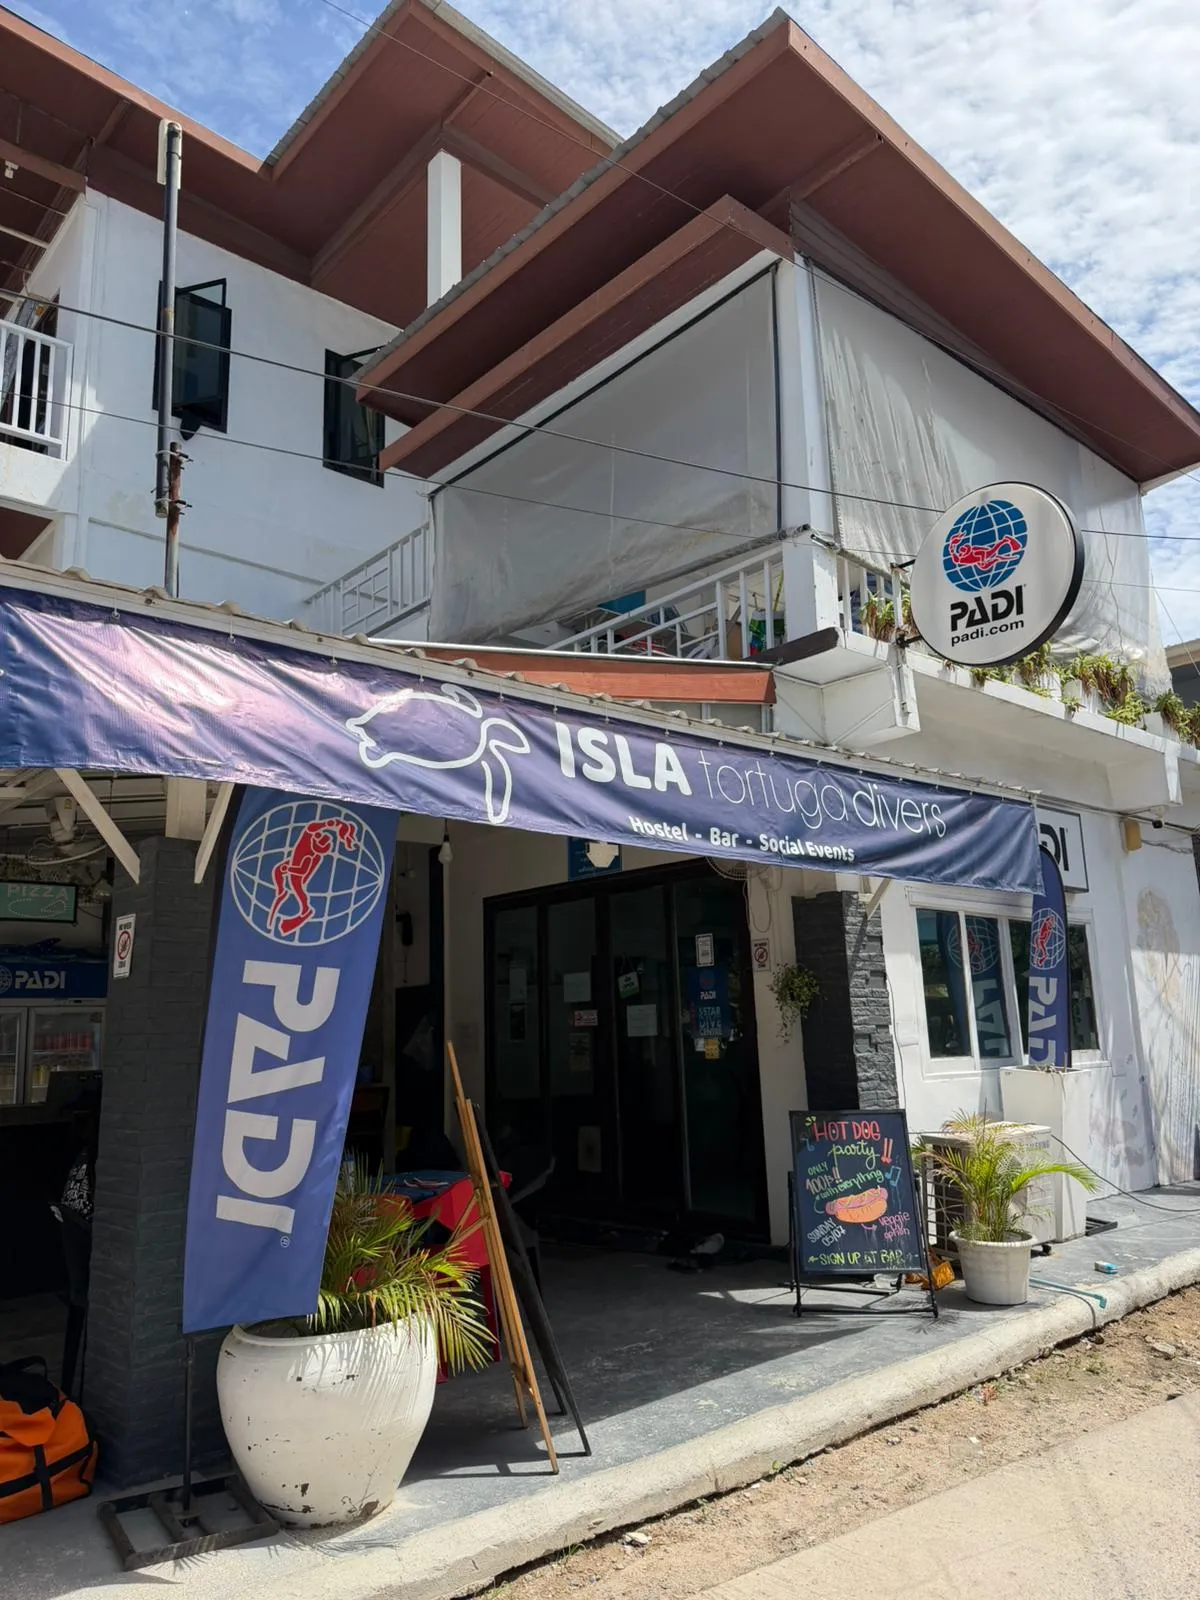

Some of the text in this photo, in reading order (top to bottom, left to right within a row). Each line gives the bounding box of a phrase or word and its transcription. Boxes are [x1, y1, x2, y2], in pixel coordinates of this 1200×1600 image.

[951, 585, 1024, 632] PADI
[951, 620, 1024, 647] padi.com
[555, 722, 946, 838] ISLA tortuga divers
[629, 816, 688, 841] Hostel
[710, 827, 739, 848] Bar
[759, 833, 804, 856] Social
[807, 841, 855, 862] Events
[7, 884, 68, 900] PIZZA
[15, 970, 66, 989] PADI
[216, 960, 341, 1235] PADI
[812, 1120, 881, 1141] HOT DOG
[827, 1140, 880, 1170] party
[808, 1161, 828, 1176] ONLY
[837, 1169, 884, 1192] everything
[807, 1217, 837, 1243] SUNDAY
[878, 1211, 911, 1229] veggie
[821, 1225, 846, 1247] 05/07
[884, 1224, 911, 1241] option
[819, 1249, 905, 1265] SIGN UP AT BAR
